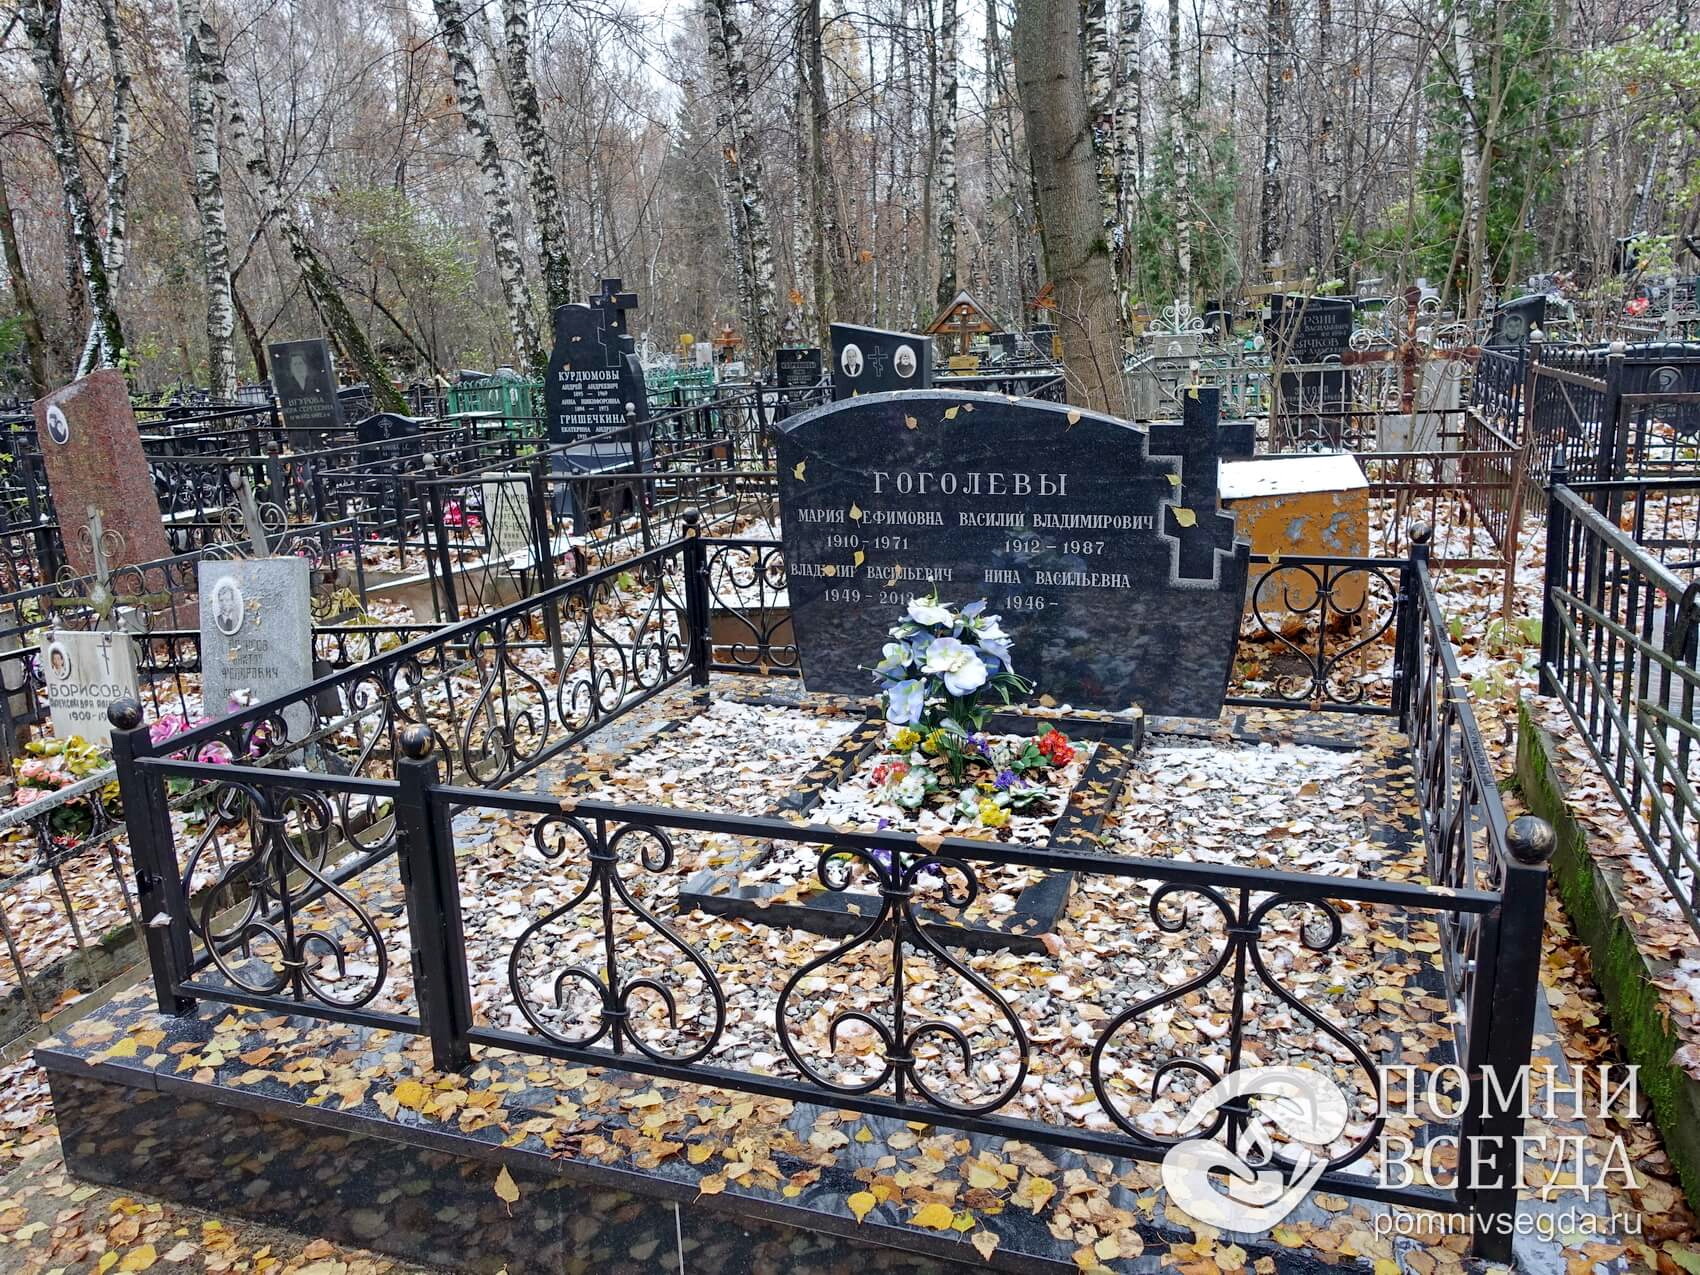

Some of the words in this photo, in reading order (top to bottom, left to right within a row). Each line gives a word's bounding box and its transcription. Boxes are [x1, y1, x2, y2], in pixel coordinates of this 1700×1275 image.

[558, 370, 620, 382] КУРДЮМОВЫ
[560, 413, 626, 425] ГРИШЕЧКИНА
[873, 471, 1068, 496] ГОГОЛЕВЫ
[798, 508, 845, 524] МАРИЯ
[861, 510, 945, 526] ЕФИМОВНА
[959, 511, 1025, 527] ВАСИЛИЙ
[1032, 513, 1154, 530] ВЛАДИМИРОВИЧ
[984, 569, 1022, 584] НИНА
[1035, 570, 1131, 588] ВАСИЛЬЕВНА
[49, 683, 133, 697] БОРИСОВА
